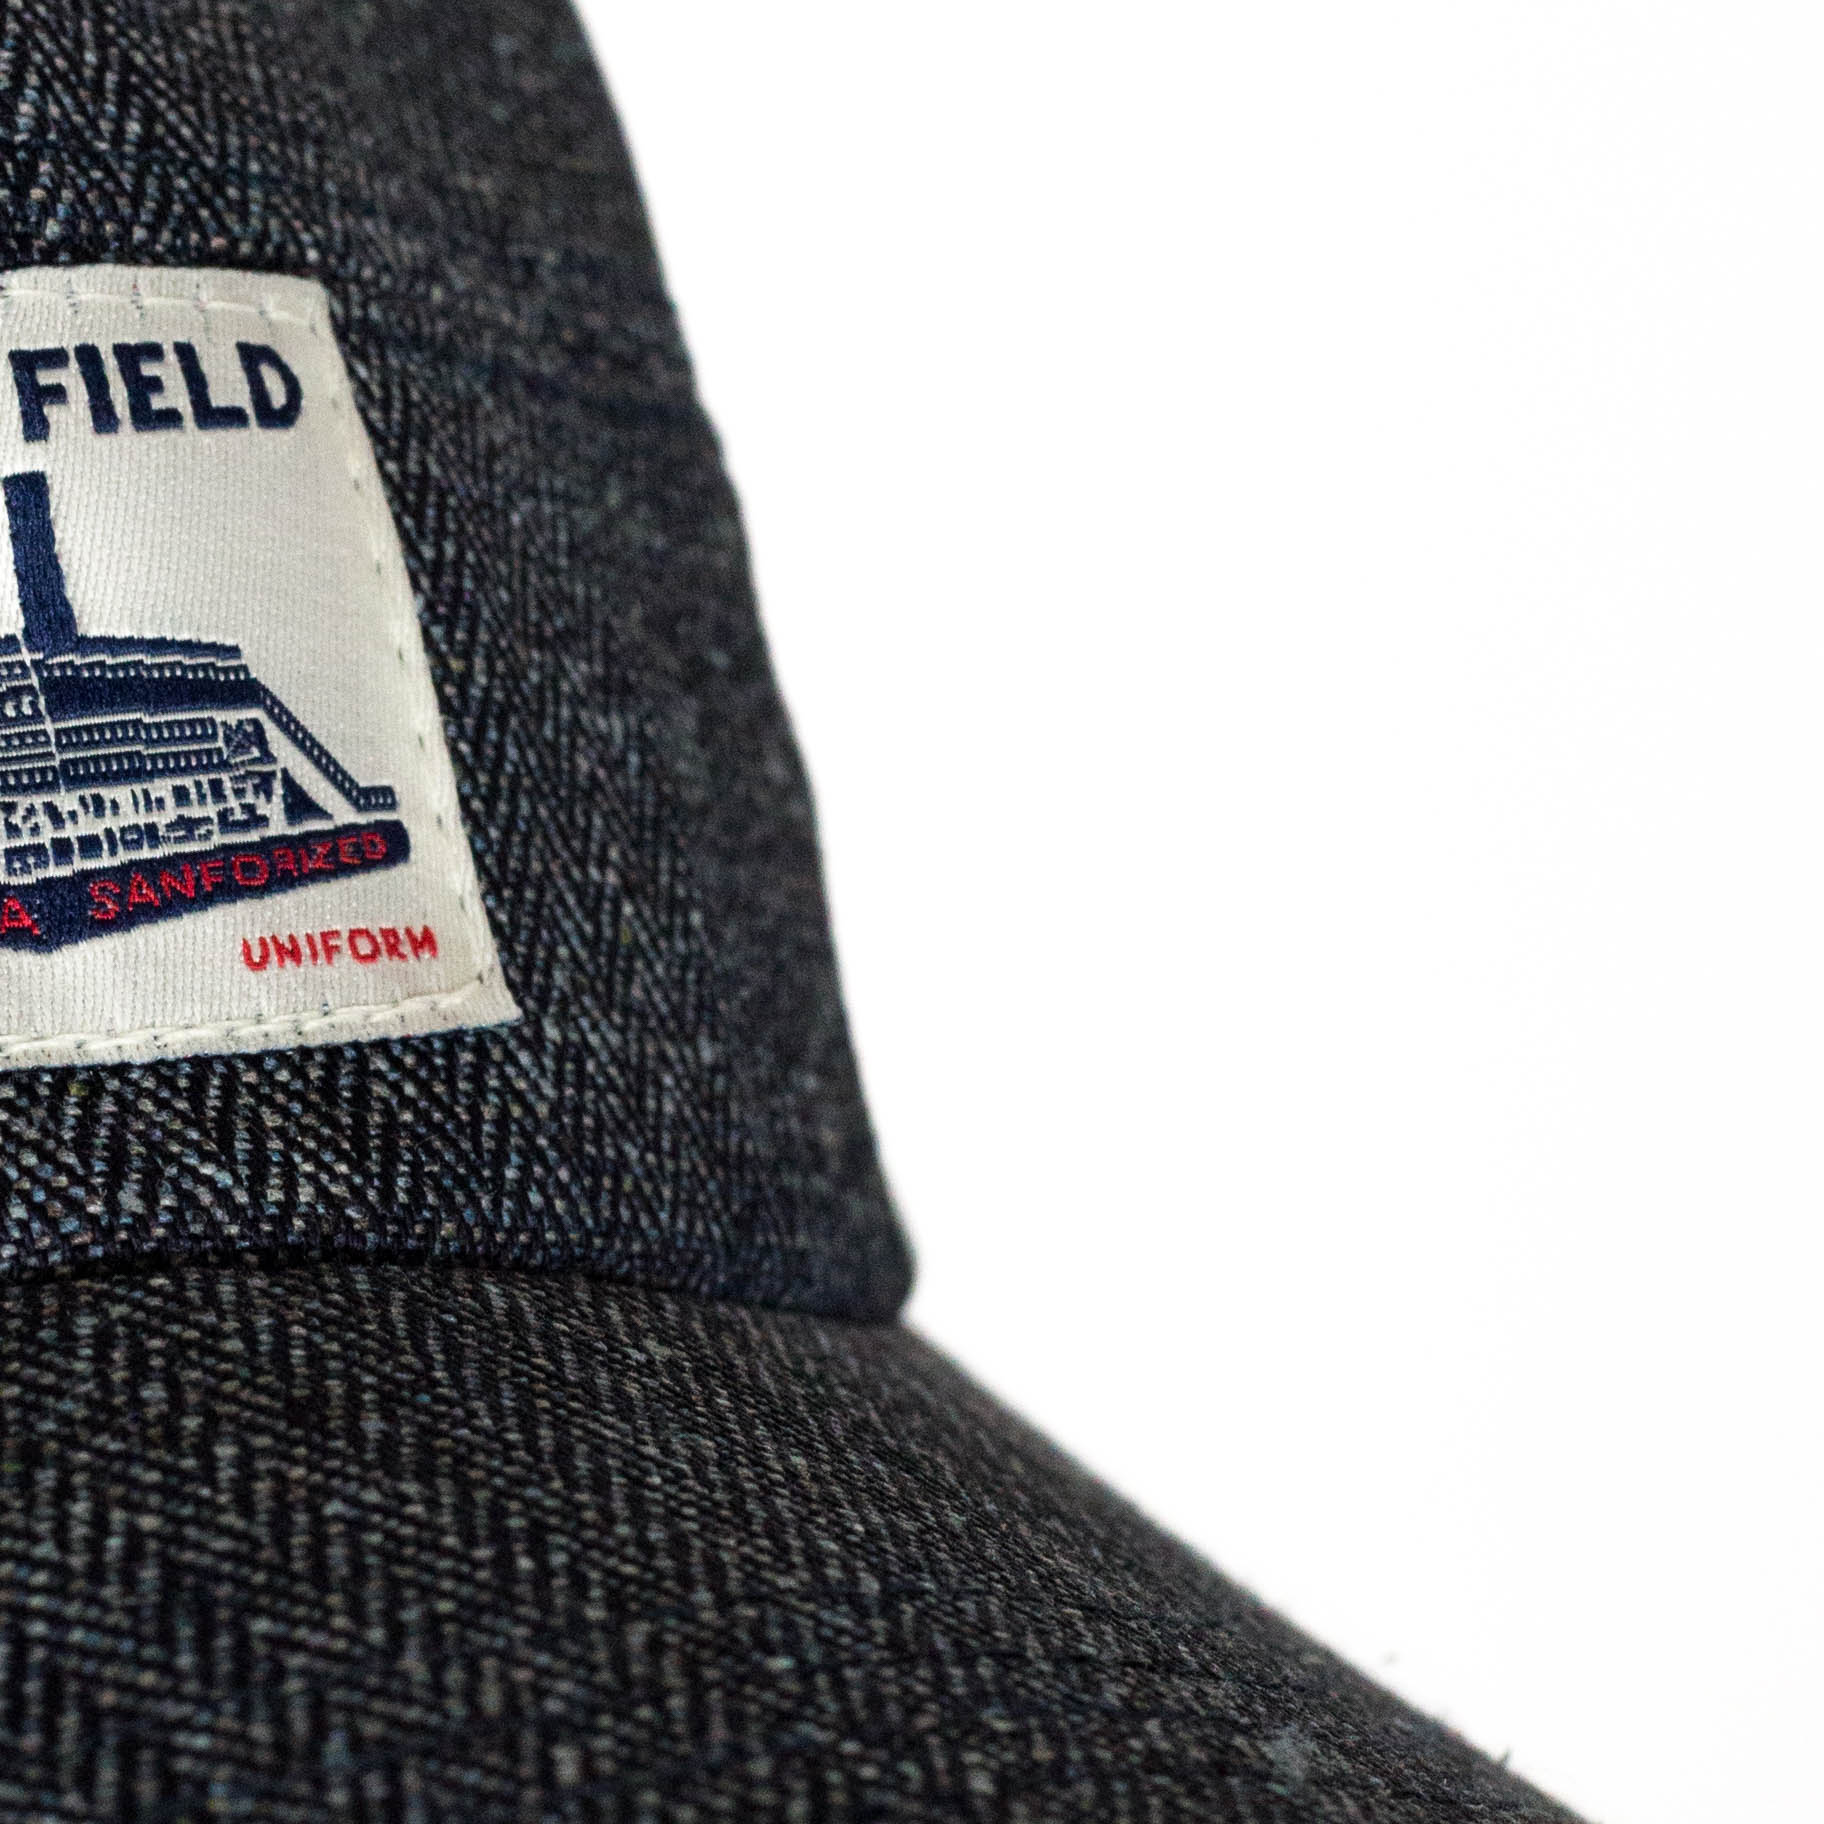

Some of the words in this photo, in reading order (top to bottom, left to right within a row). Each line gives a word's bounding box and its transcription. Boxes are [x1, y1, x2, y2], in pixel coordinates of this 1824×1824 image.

[8, 340, 304, 443] FIELD
[88, 831, 389, 921] SANFORIZED
[241, 924, 440, 972] UNIFORM
